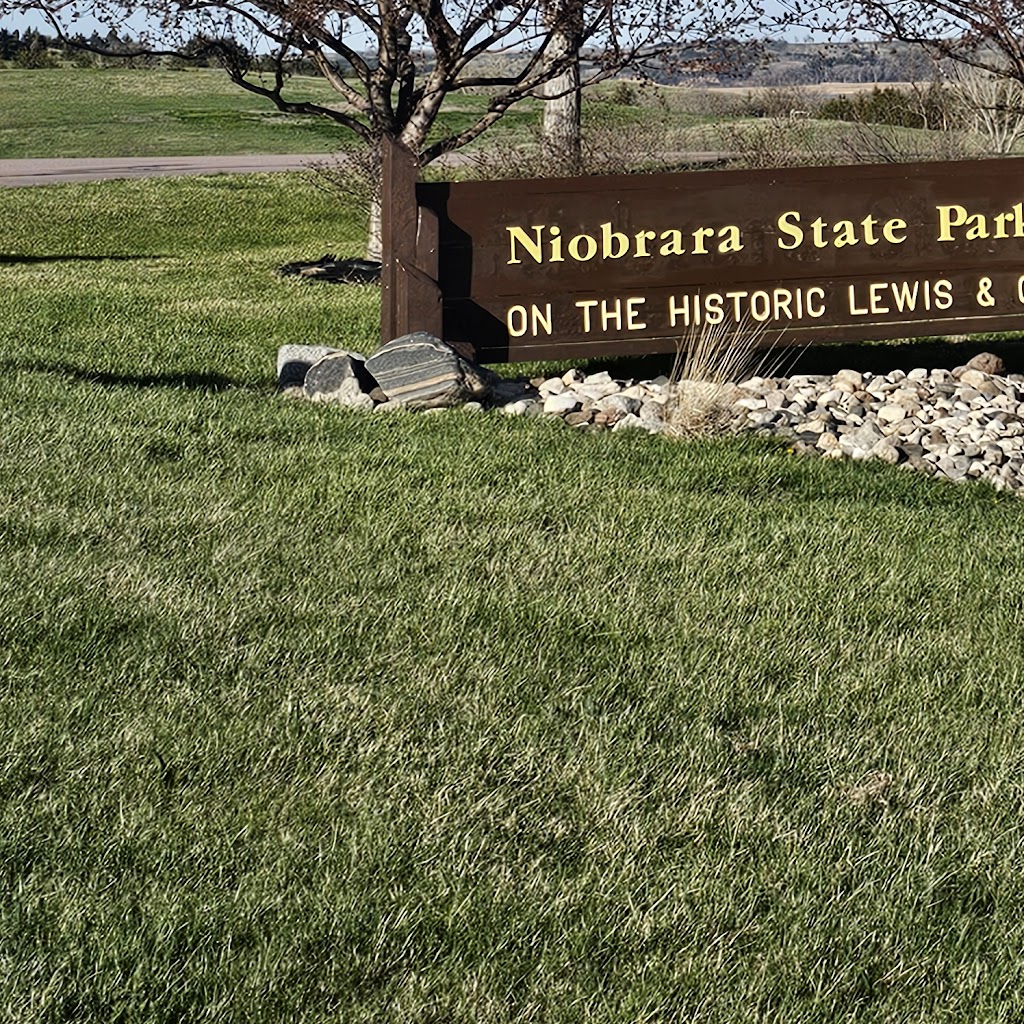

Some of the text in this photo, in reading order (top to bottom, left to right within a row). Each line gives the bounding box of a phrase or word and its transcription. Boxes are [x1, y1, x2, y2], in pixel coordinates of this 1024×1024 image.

[506, 221, 744, 265] Niobrara
[777, 211, 908, 250] State
[507, 303, 553, 337] ON
[575, 297, 646, 333] THE
[669, 287, 826, 327] HISTORIC
[849, 279, 953, 316] LEWIS
[976, 278, 996, 307] &
